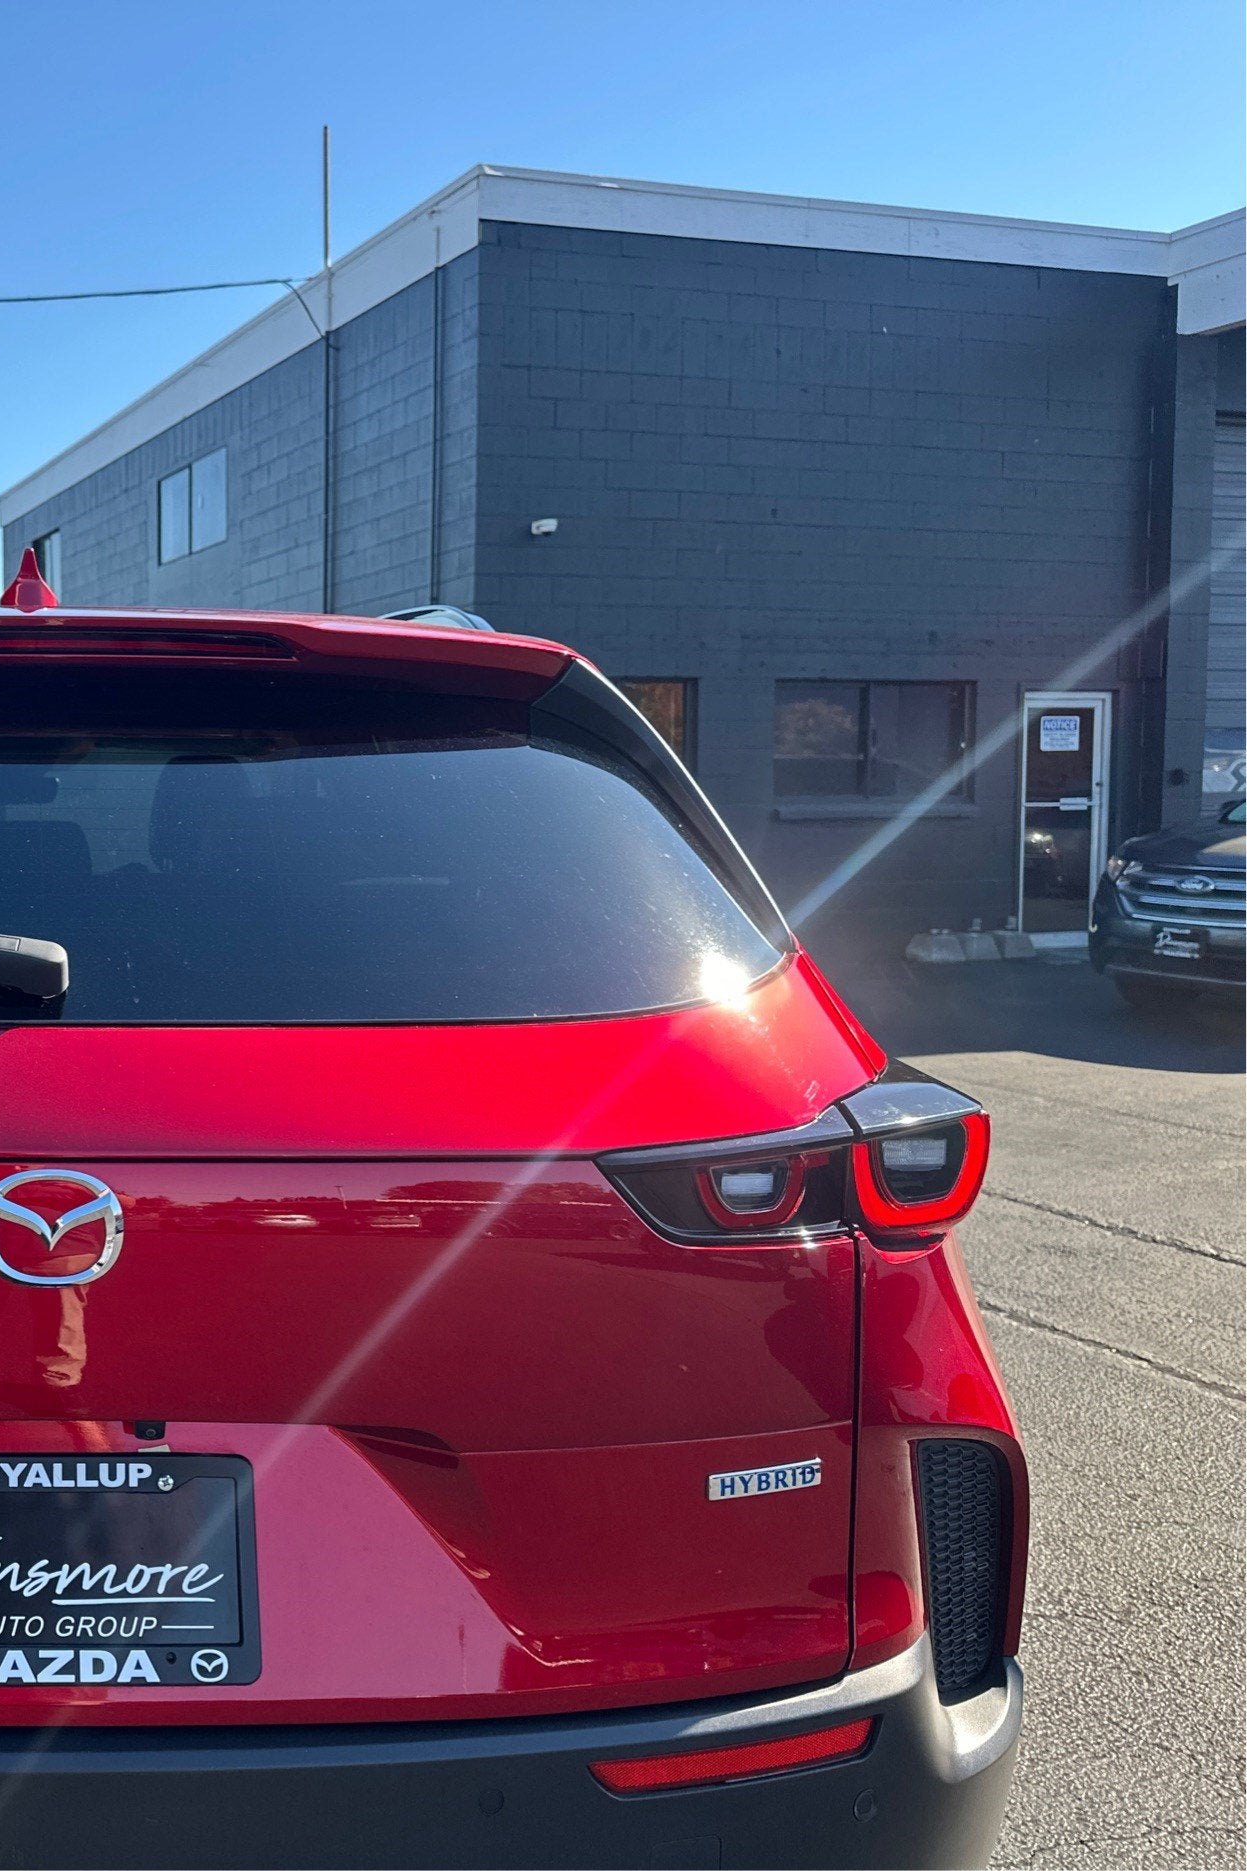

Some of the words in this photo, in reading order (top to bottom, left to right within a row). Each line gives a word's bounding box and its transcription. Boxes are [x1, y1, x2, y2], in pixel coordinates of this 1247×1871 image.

[1043, 719, 1077, 730] NOTICE
[719, 1465, 816, 1497] HYBRID
[55, 1615, 157, 1638] GROUP
